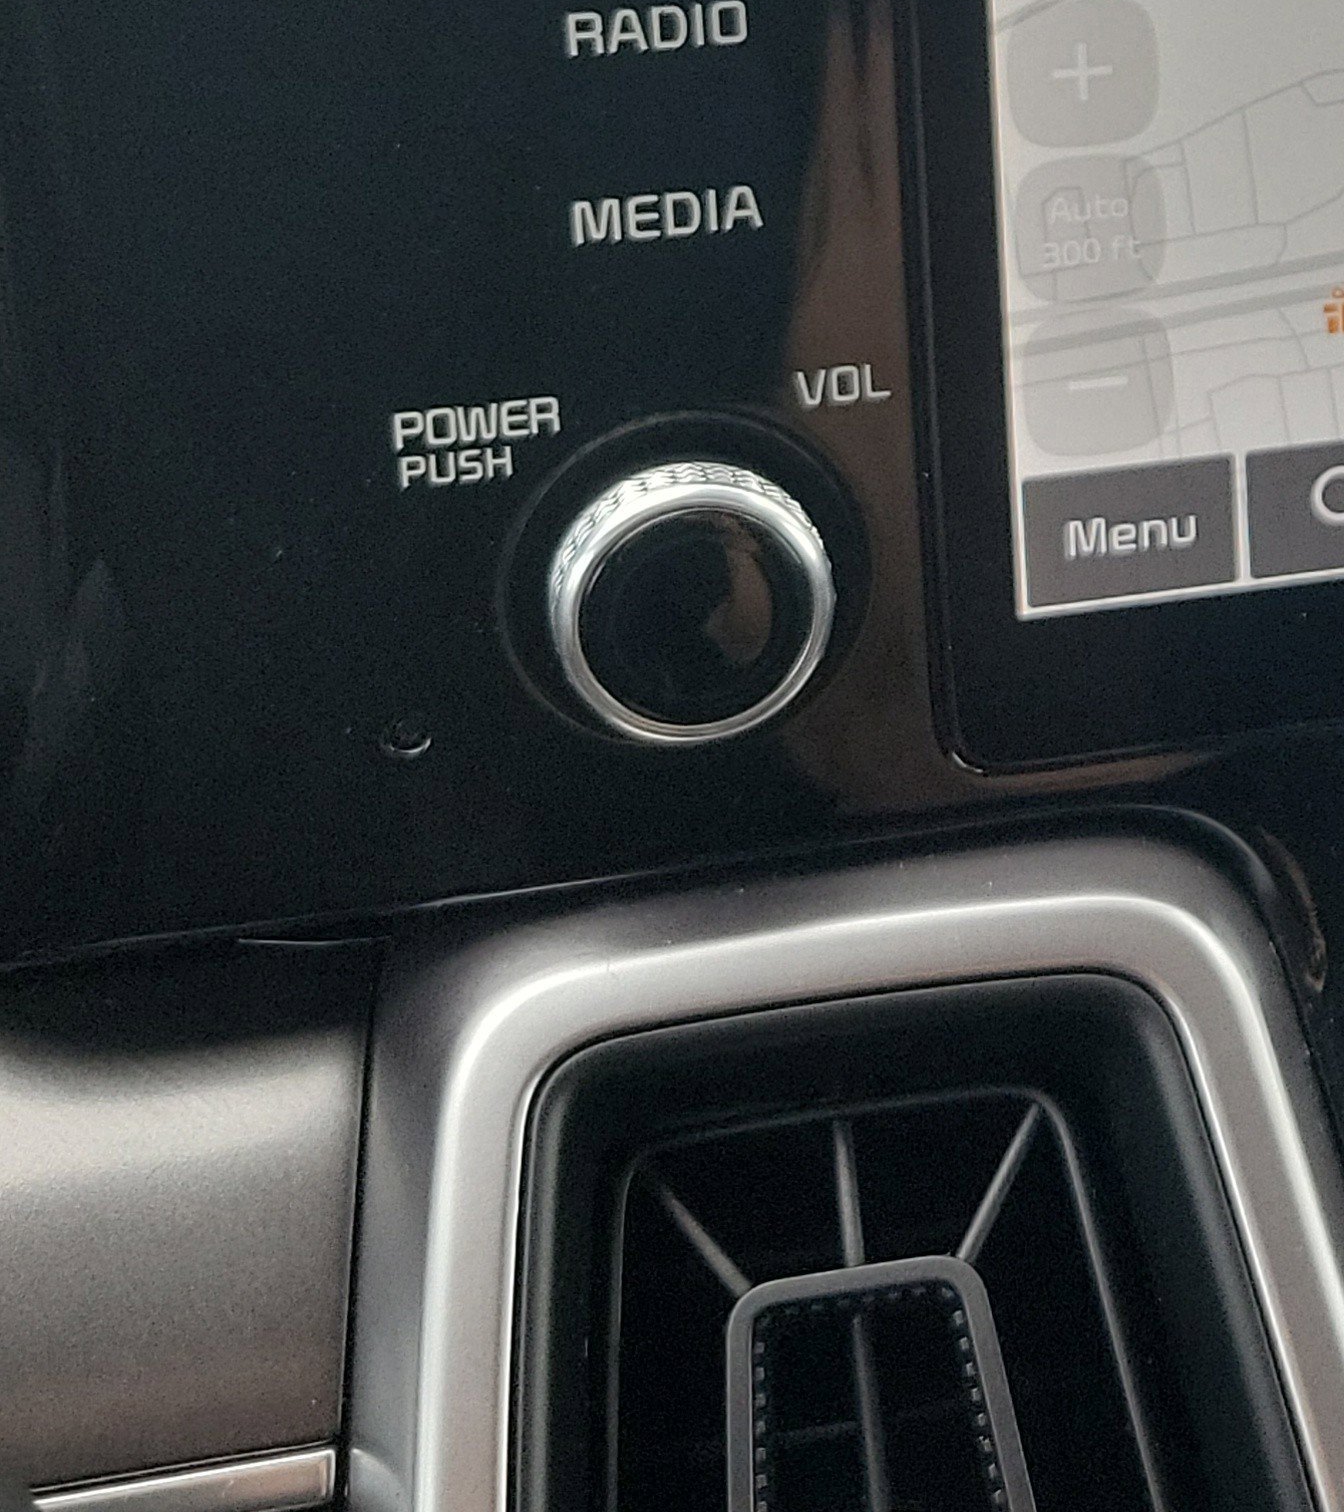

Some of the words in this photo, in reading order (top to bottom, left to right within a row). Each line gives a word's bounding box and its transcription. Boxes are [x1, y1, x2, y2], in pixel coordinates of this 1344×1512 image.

[569, 184, 765, 248] MEDIA
[796, 362, 893, 407] VOL
[392, 395, 562, 452] POWER
[399, 444, 514, 489] PUSH
[1063, 512, 1199, 561] Menu
